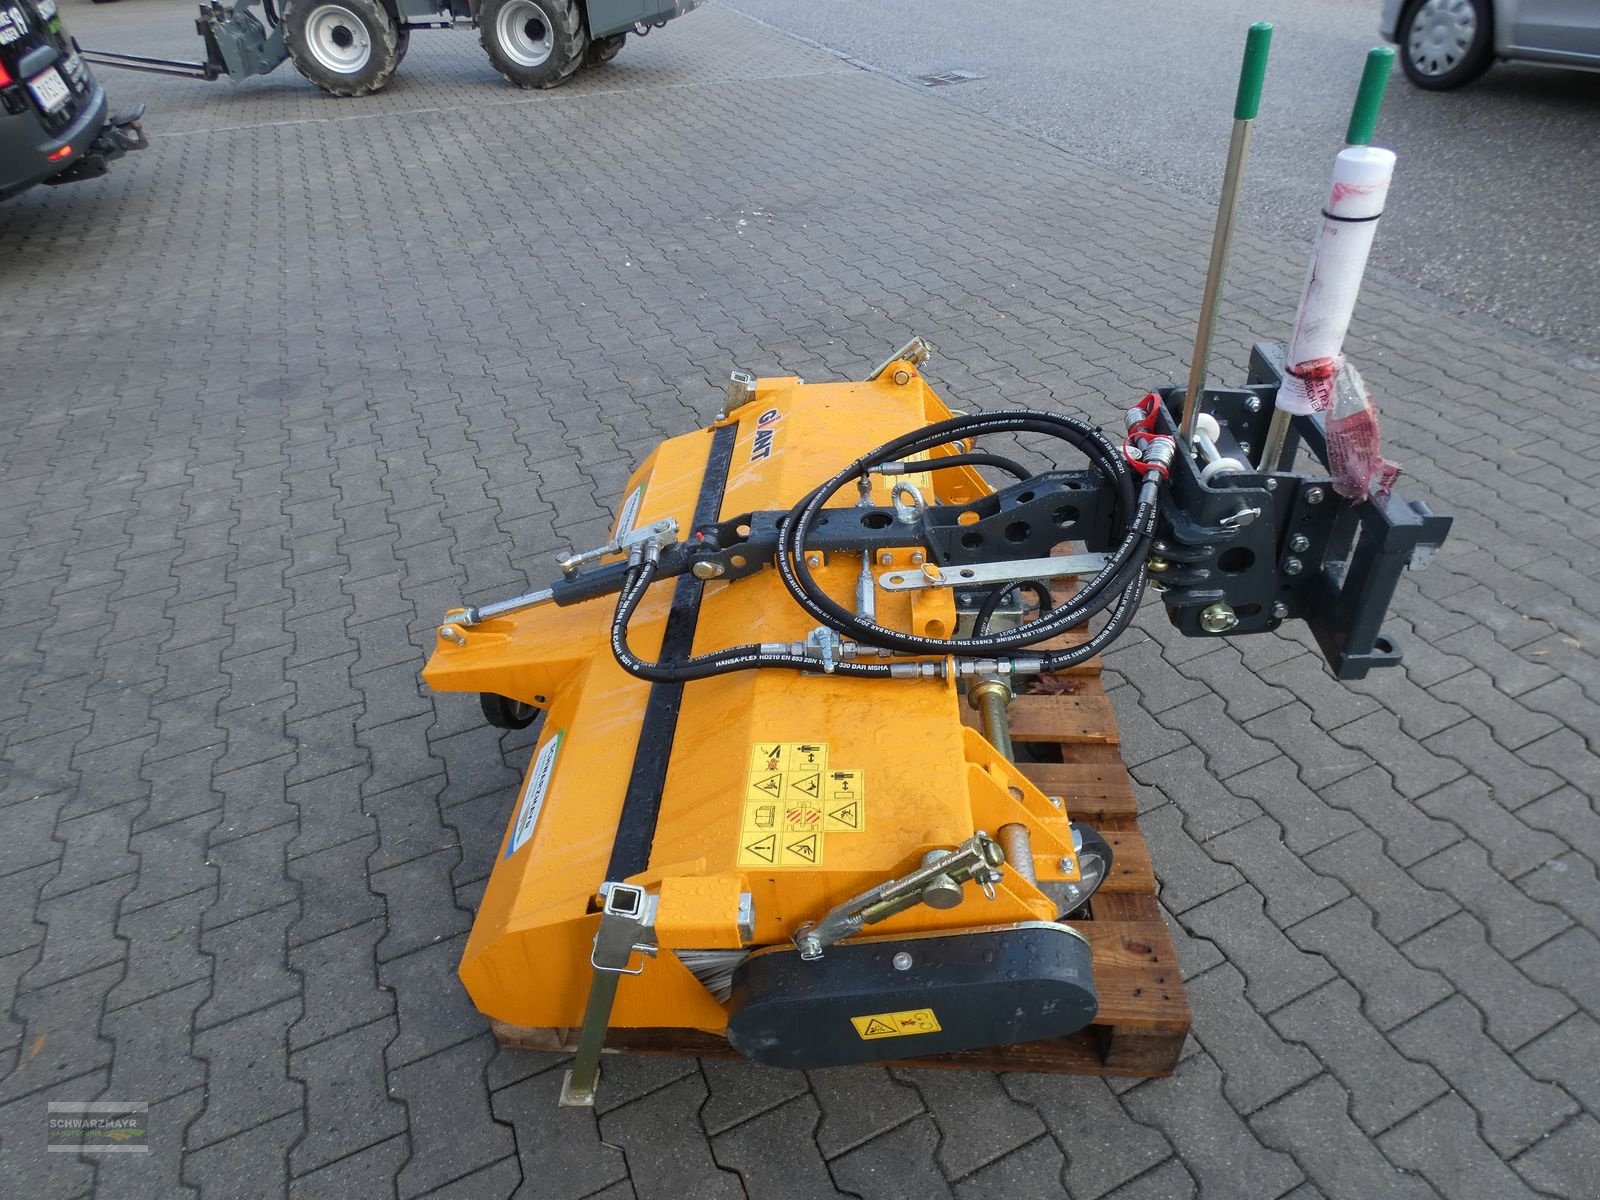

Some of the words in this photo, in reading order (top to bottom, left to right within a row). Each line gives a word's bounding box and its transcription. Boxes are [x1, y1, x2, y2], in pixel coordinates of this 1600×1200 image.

[751, 409, 783, 461] GIANT
[1053, 607, 1088, 628] HYDRAULIK
[995, 633, 1021, 644] RHEINE
[1022, 624, 1053, 638] MUELLER
